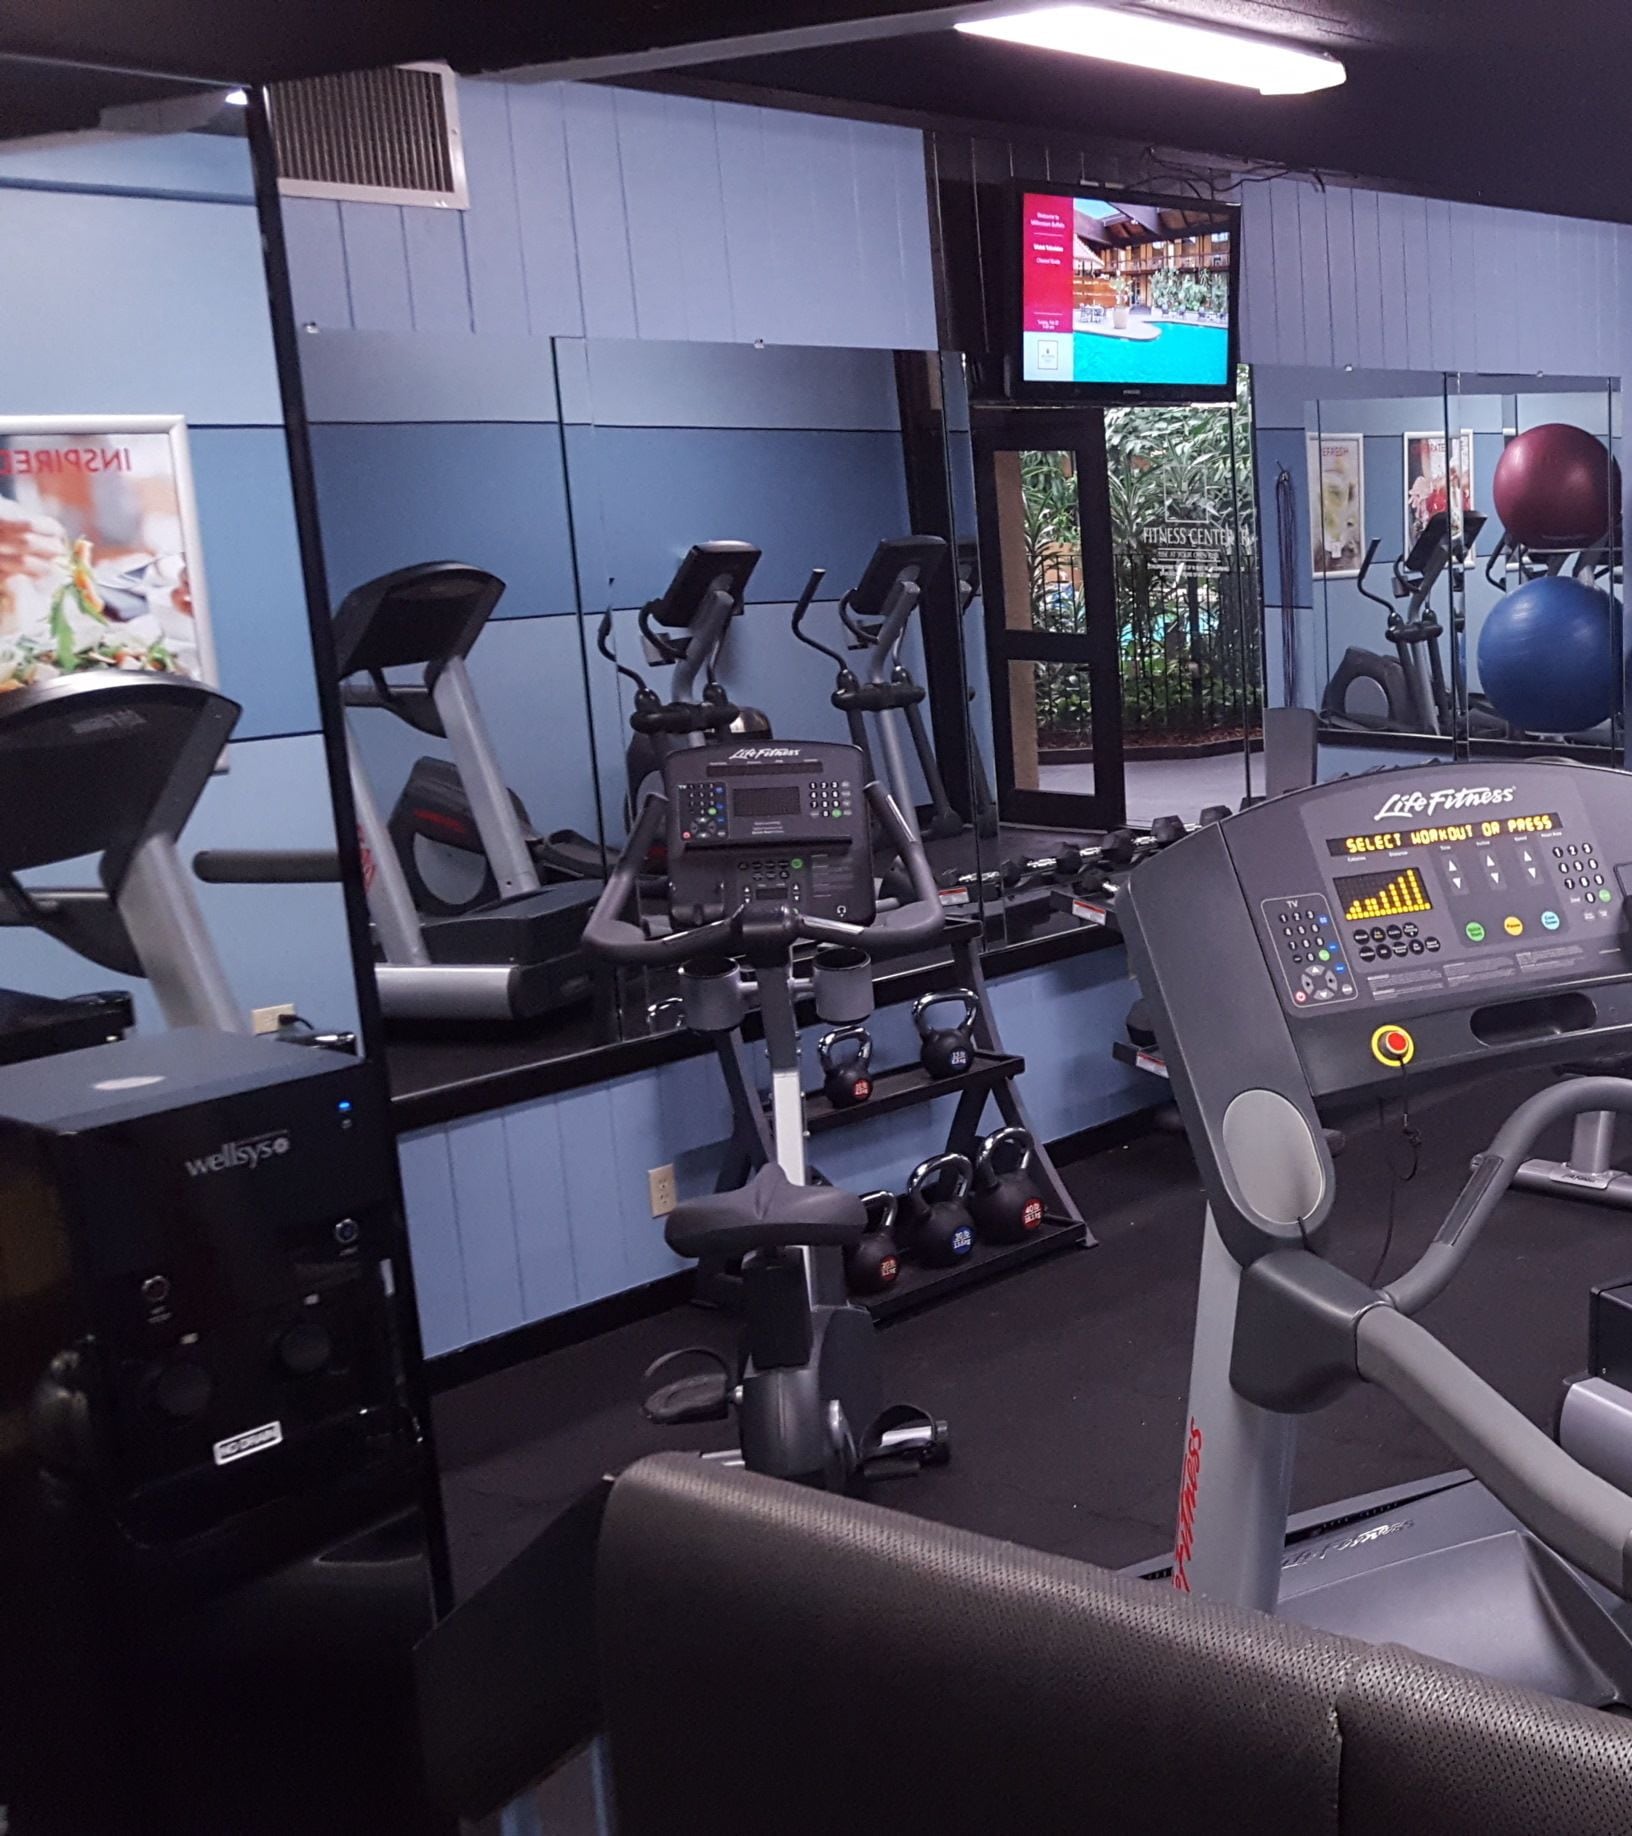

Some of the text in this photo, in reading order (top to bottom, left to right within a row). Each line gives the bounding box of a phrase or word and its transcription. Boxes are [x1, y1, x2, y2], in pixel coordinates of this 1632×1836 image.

[1143, 527, 1234, 545] FITNESS CENTER
[1346, 815, 1552, 853] SELECT WORKOUT OR PRESS
[1286, 900, 1298, 909] TV
